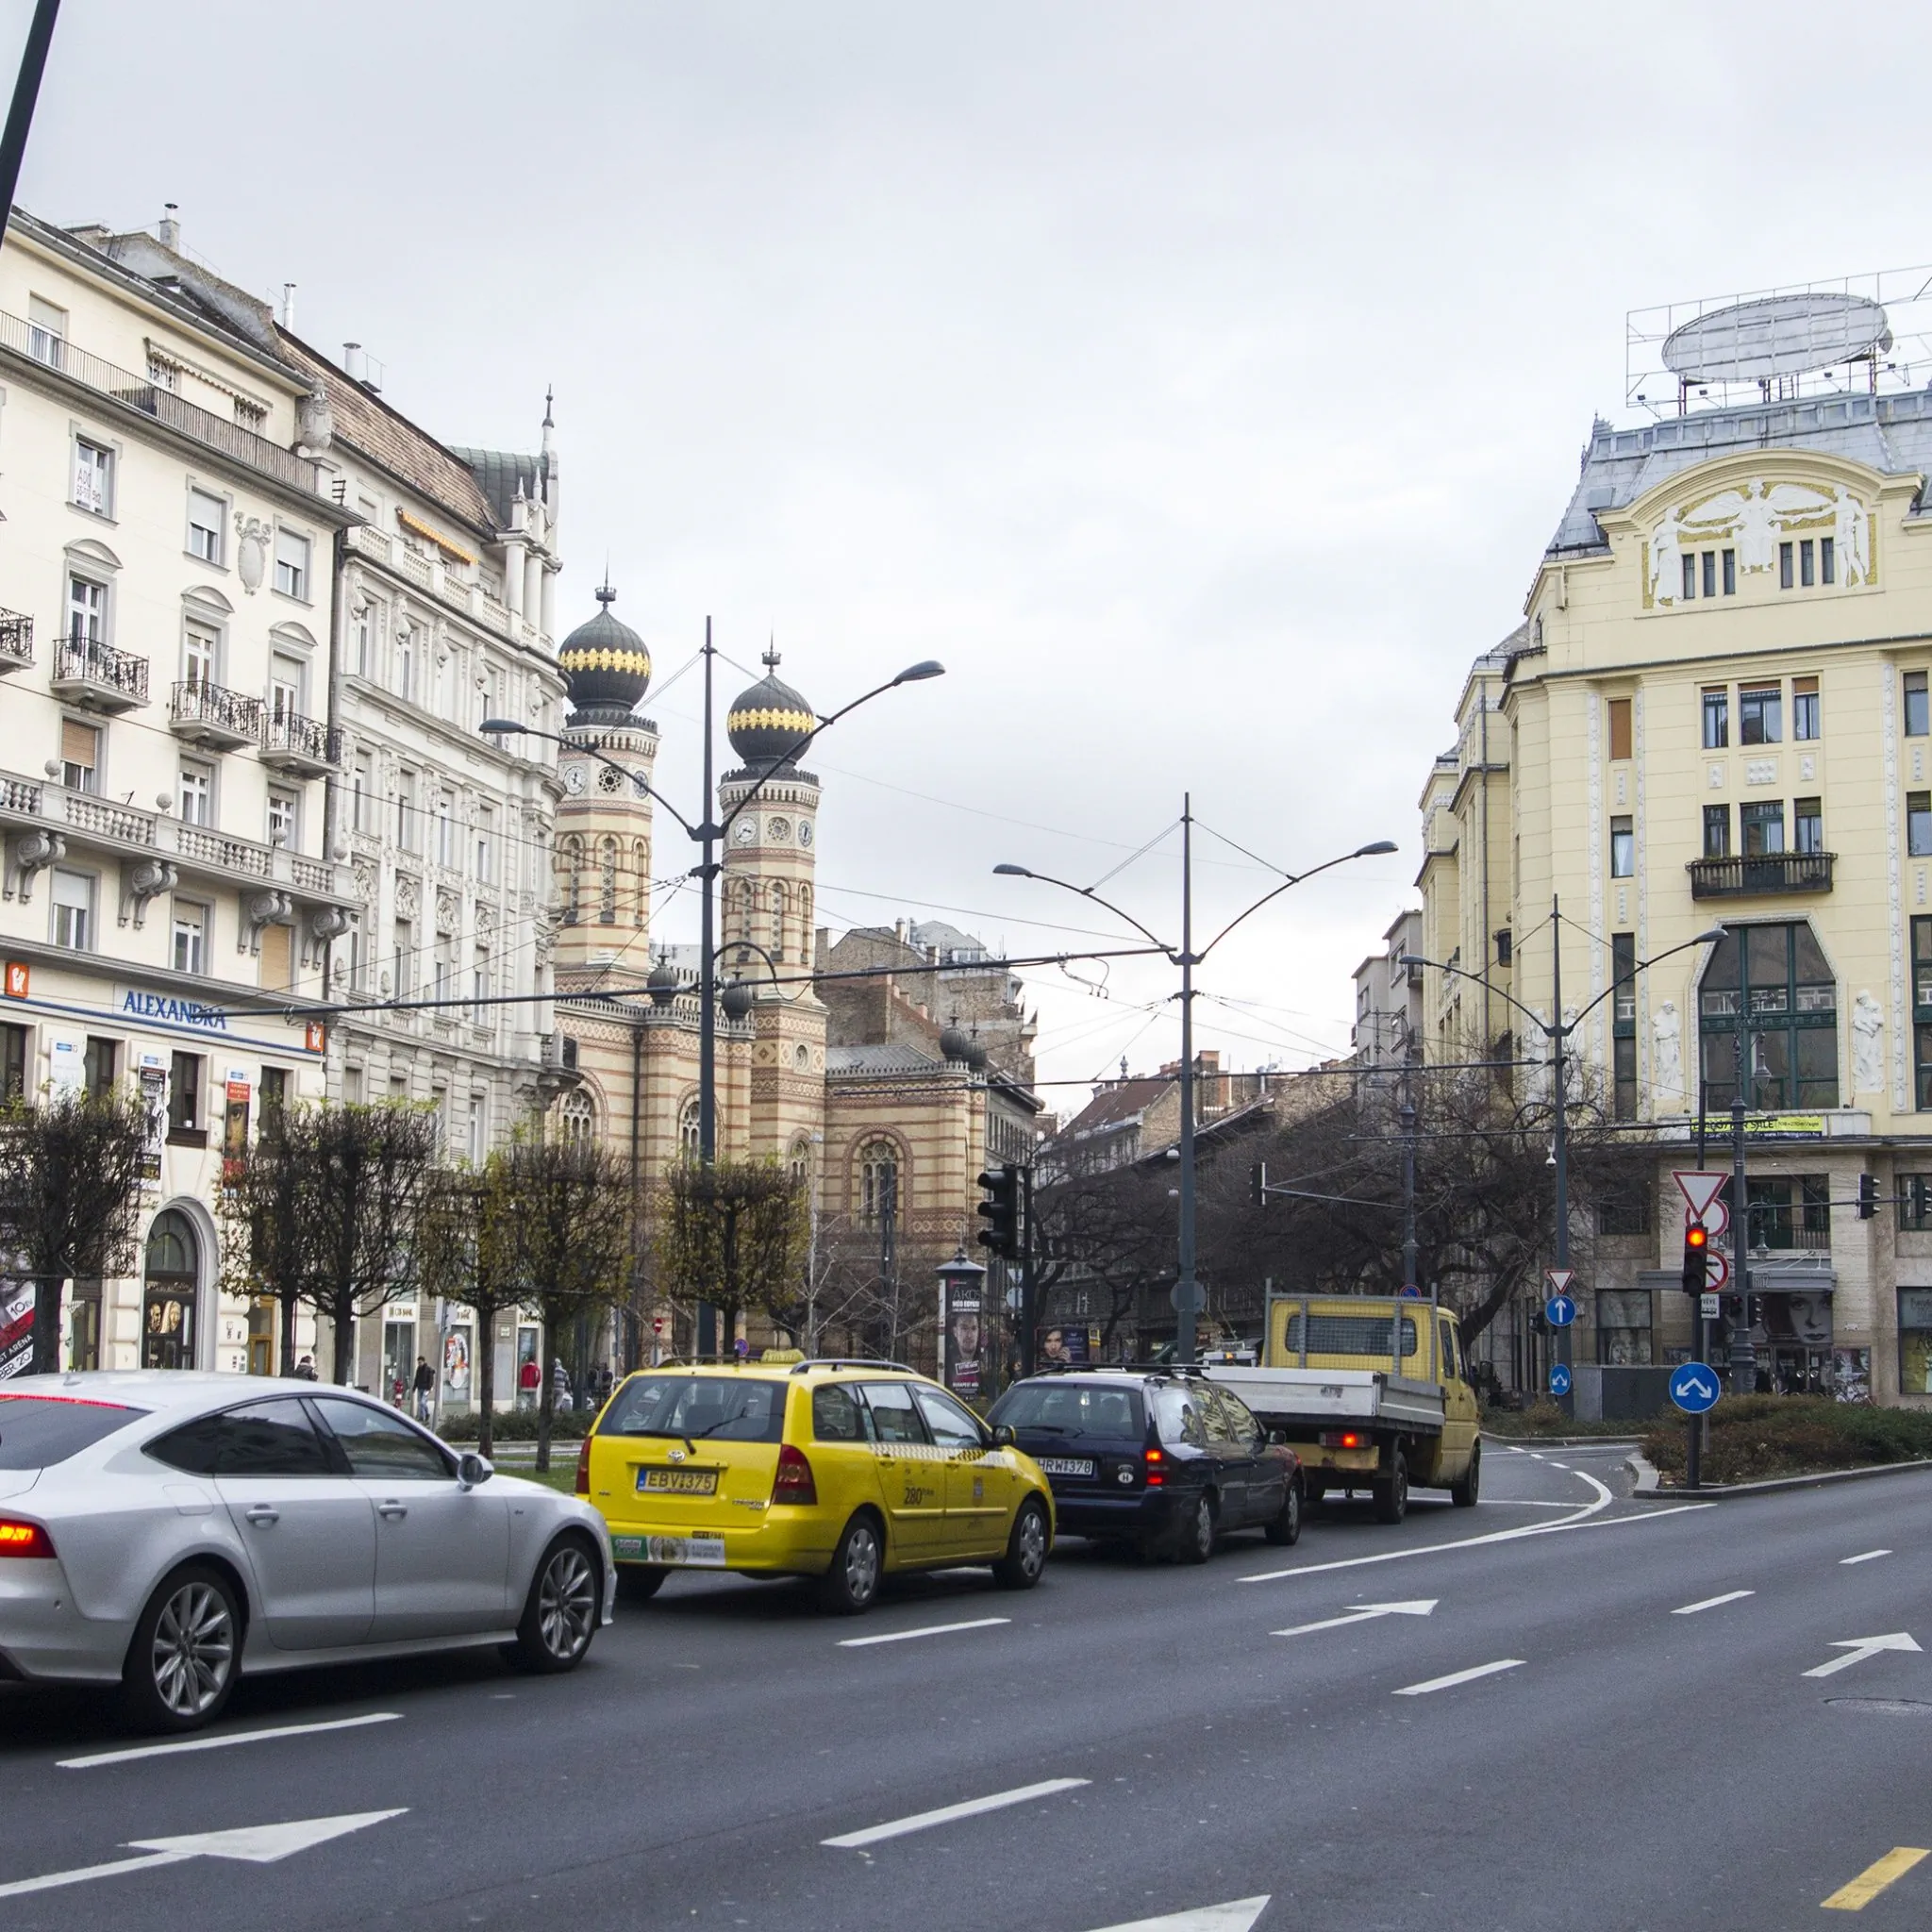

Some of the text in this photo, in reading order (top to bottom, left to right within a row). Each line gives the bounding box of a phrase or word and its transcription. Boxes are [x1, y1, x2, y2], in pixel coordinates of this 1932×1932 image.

[124, 990, 226, 1030] ALEXANDRA
[16, 1351, 31, 1367] 20
[905, 1487, 922, 1505] 280
